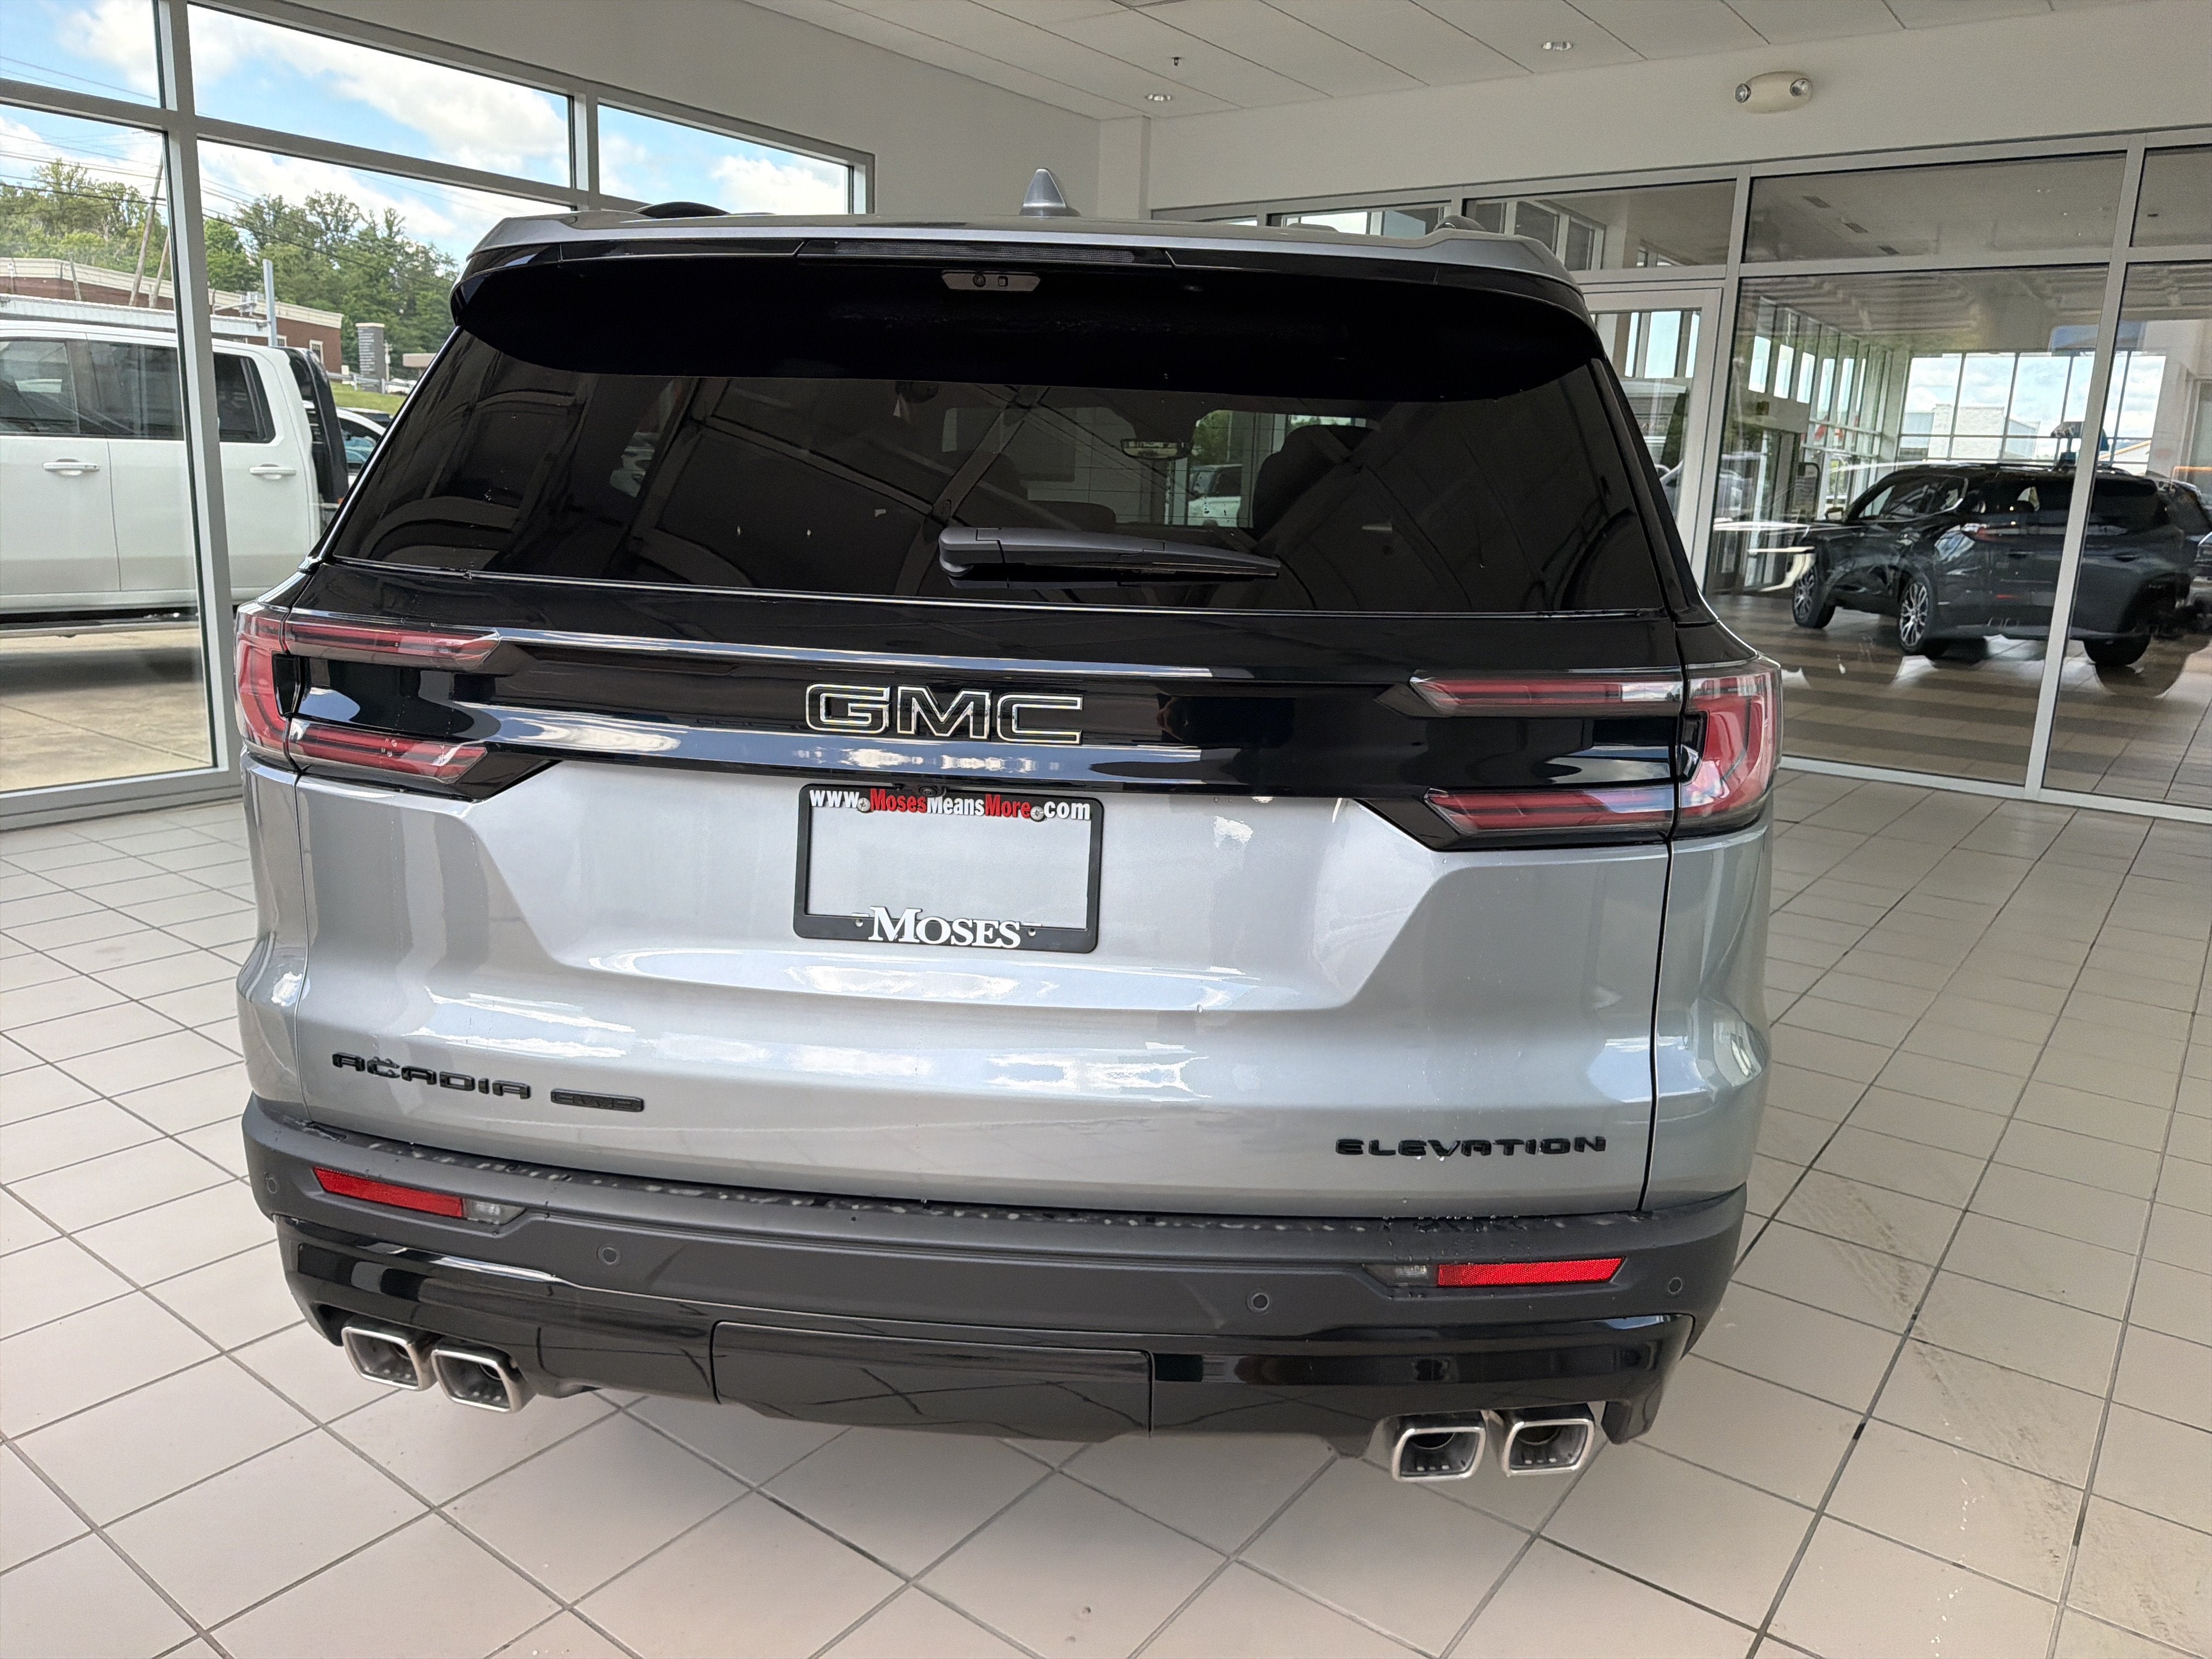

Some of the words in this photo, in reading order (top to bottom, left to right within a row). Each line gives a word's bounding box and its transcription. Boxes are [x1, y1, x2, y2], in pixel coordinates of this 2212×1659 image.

[806, 684, 1084, 745] GMC
[868, 905, 1021, 949] MOSES
[332, 1052, 531, 1099] ACADIA
[1335, 1136, 1606, 1157] ELEVATION
